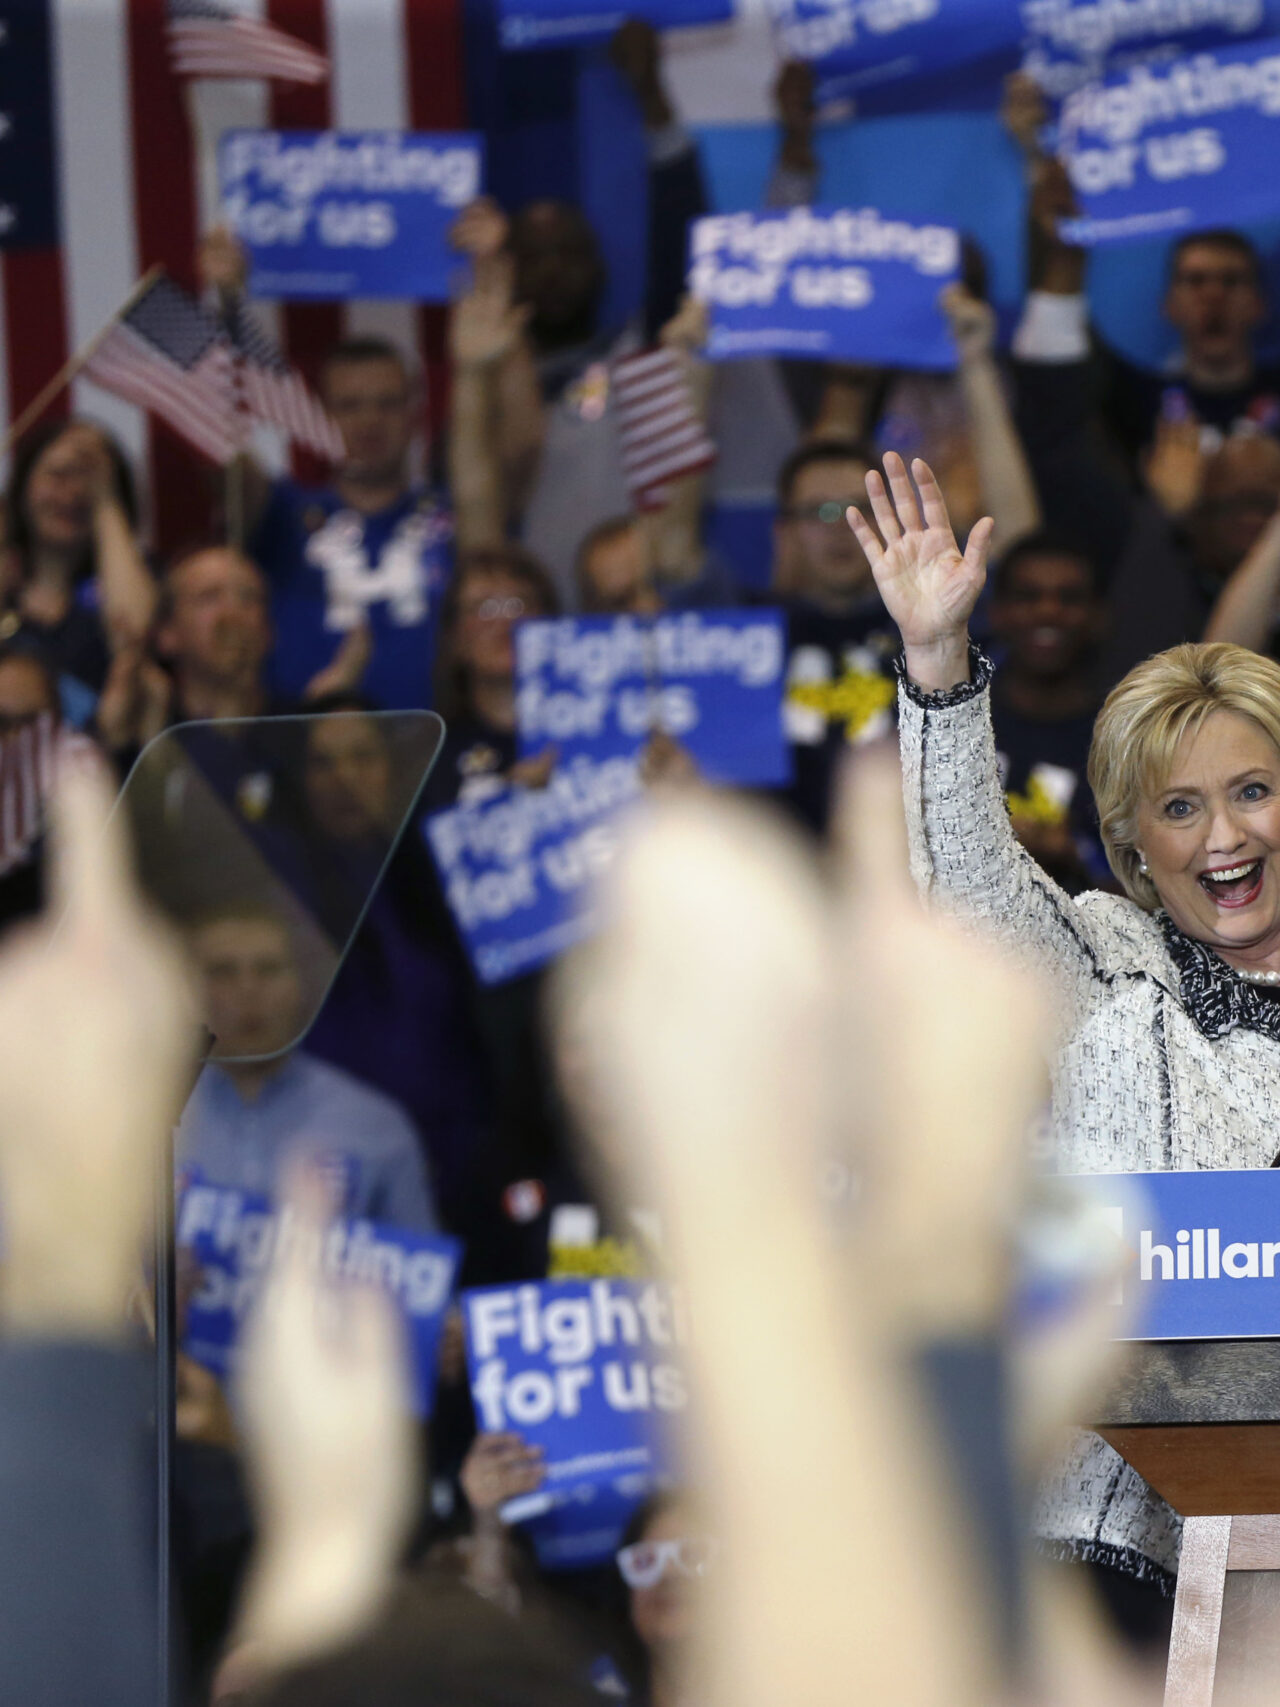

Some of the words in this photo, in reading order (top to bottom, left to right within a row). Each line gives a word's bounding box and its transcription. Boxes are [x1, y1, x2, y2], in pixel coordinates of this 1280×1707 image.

[226, 134, 482, 206] Fighting
[1146, 127, 1226, 181] us
[314, 199, 397, 248] us
[690, 206, 959, 276] Fighting
[689, 255, 783, 309] for
[790, 264, 873, 310] us
[516, 612, 785, 688] Fighting
[516, 675, 605, 742] for
[617, 684, 698, 738] us
[427, 754, 645, 872] Fightin
[467, 1279, 676, 1364] Fight
[472, 1357, 592, 1432] for
[602, 1360, 692, 1413] us
